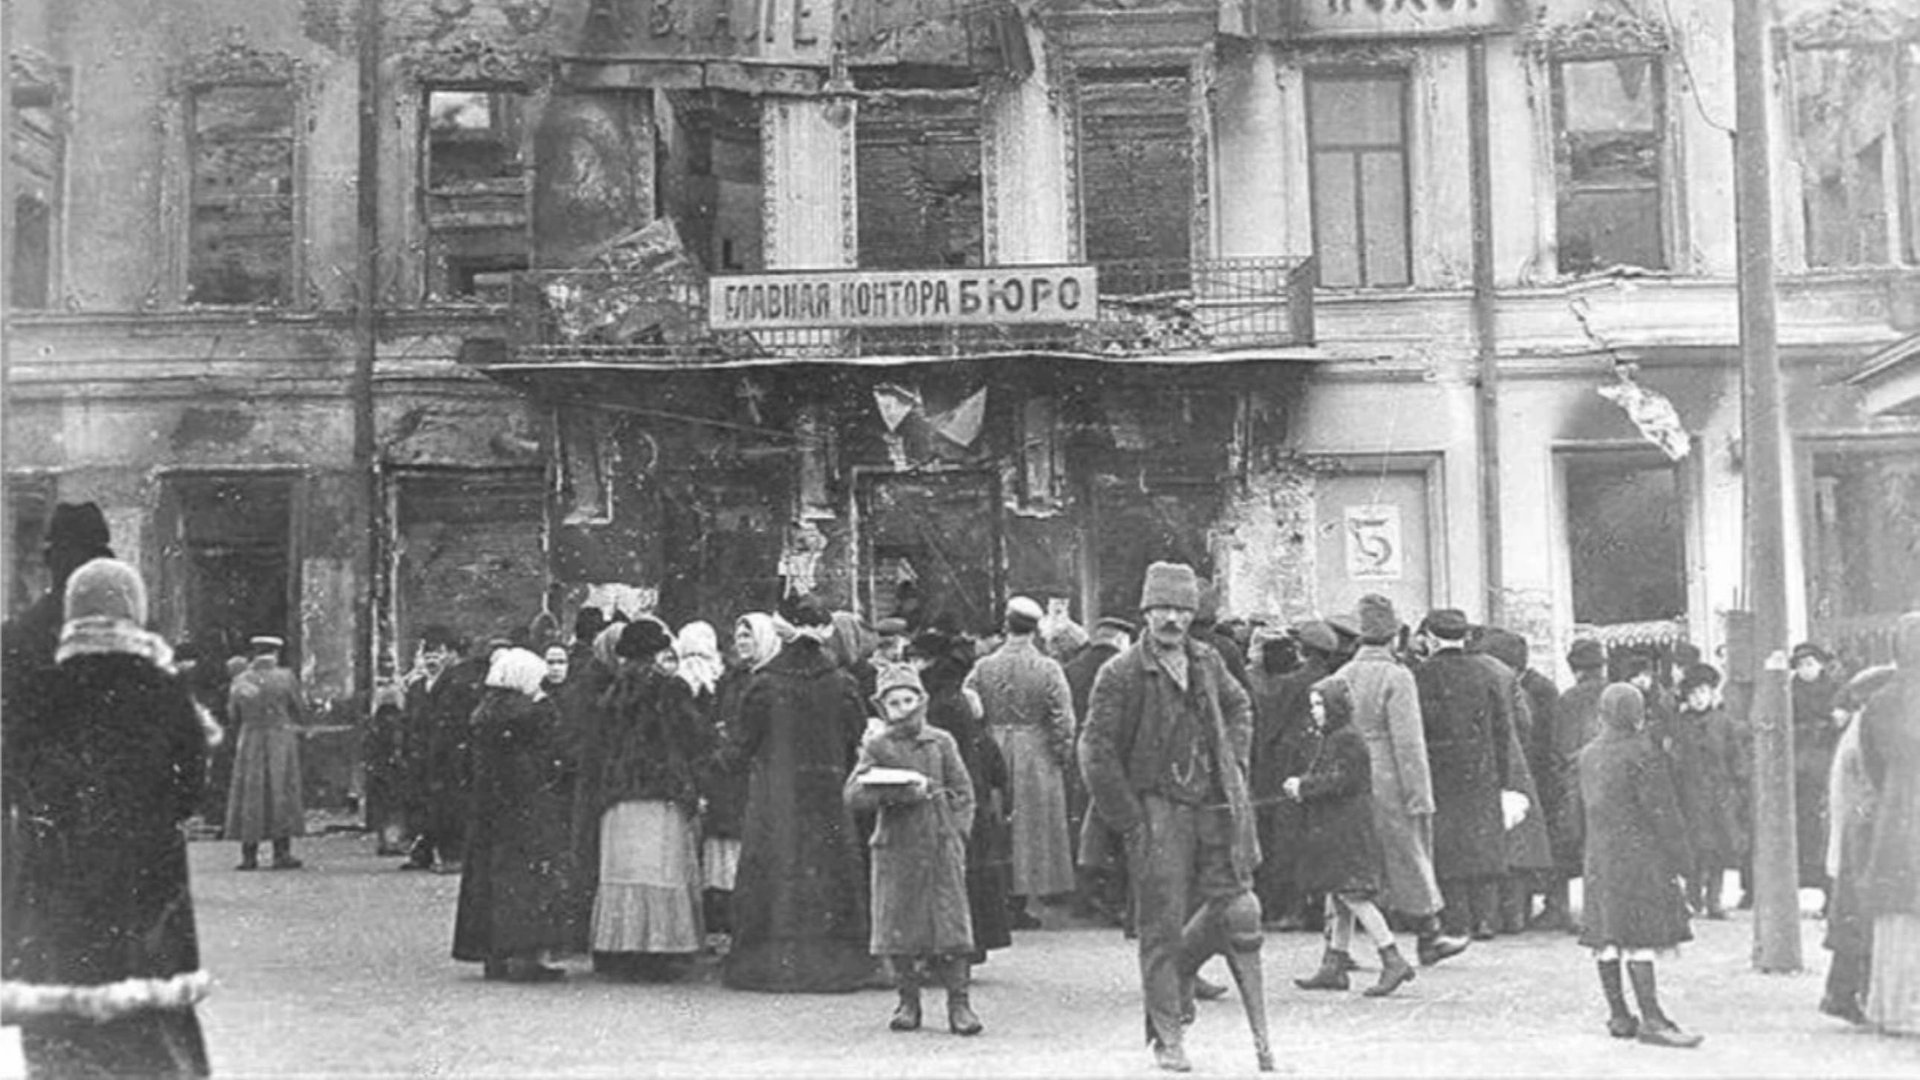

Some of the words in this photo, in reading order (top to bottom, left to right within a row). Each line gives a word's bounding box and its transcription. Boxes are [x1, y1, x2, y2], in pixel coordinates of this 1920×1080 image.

[725, 282, 830, 319] ГЛАВНАЯ
[840, 280, 949, 316] КОНТОРА
[959, 277, 1081, 315] БЮРО
